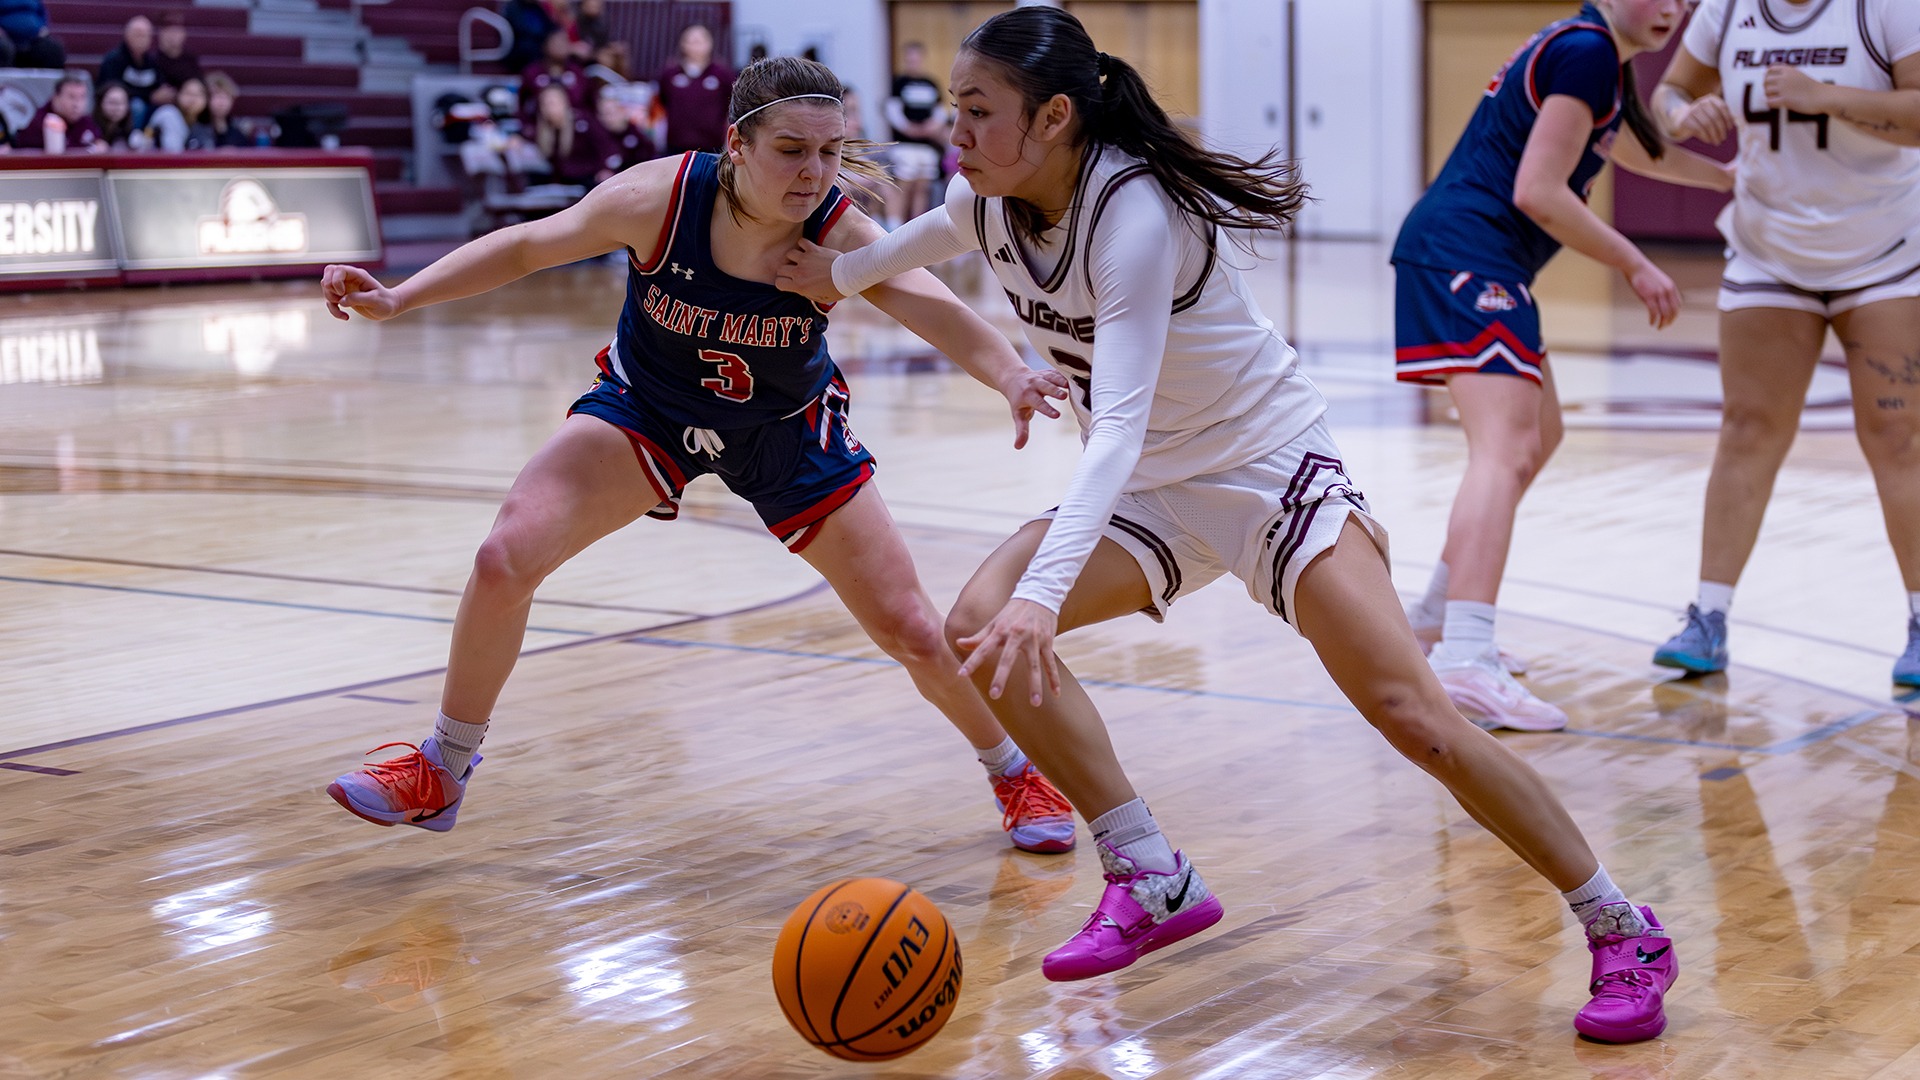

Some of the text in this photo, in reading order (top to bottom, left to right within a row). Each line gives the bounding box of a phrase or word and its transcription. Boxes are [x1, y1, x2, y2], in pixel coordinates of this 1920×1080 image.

[0, 201, 98, 254] ERSITY
[643, 284, 813, 347] SAINT MARY'S
[698, 348, 754, 403] 3
[882, 914, 930, 990] EVO
